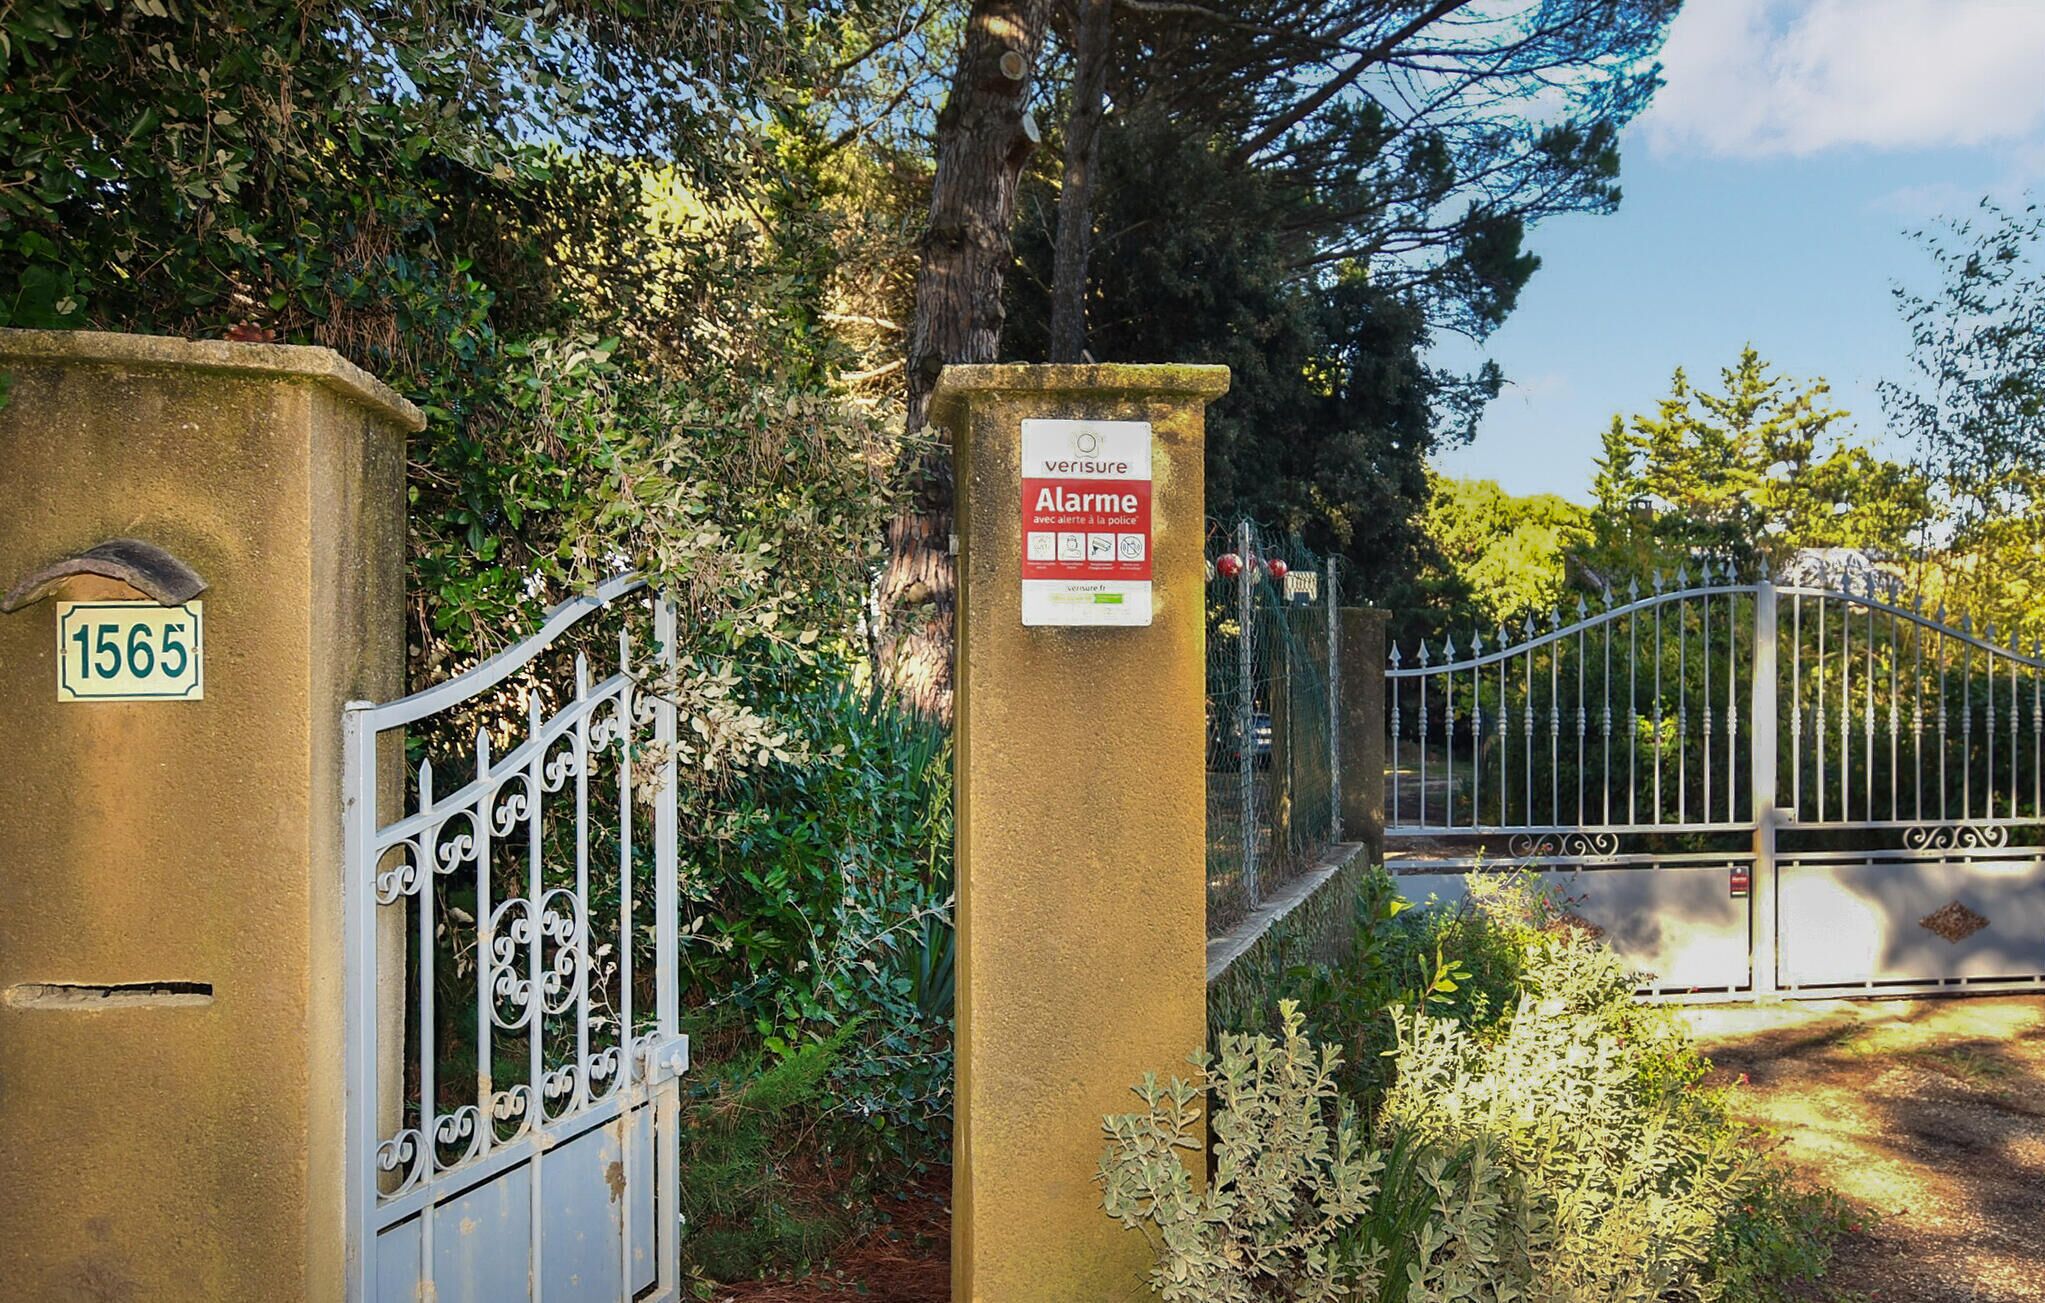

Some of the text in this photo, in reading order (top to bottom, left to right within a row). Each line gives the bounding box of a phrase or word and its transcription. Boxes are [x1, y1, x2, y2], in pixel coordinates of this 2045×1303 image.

[1045, 460, 1128, 474] verisure
[1035, 486, 1138, 513] Alarme
[1033, 515, 1055, 524] avec
[1057, 514, 1086, 525] alerte
[1088, 514, 1094, 525] à
[1097, 514, 1105, 525] la
[72, 623, 187, 679] 1565
